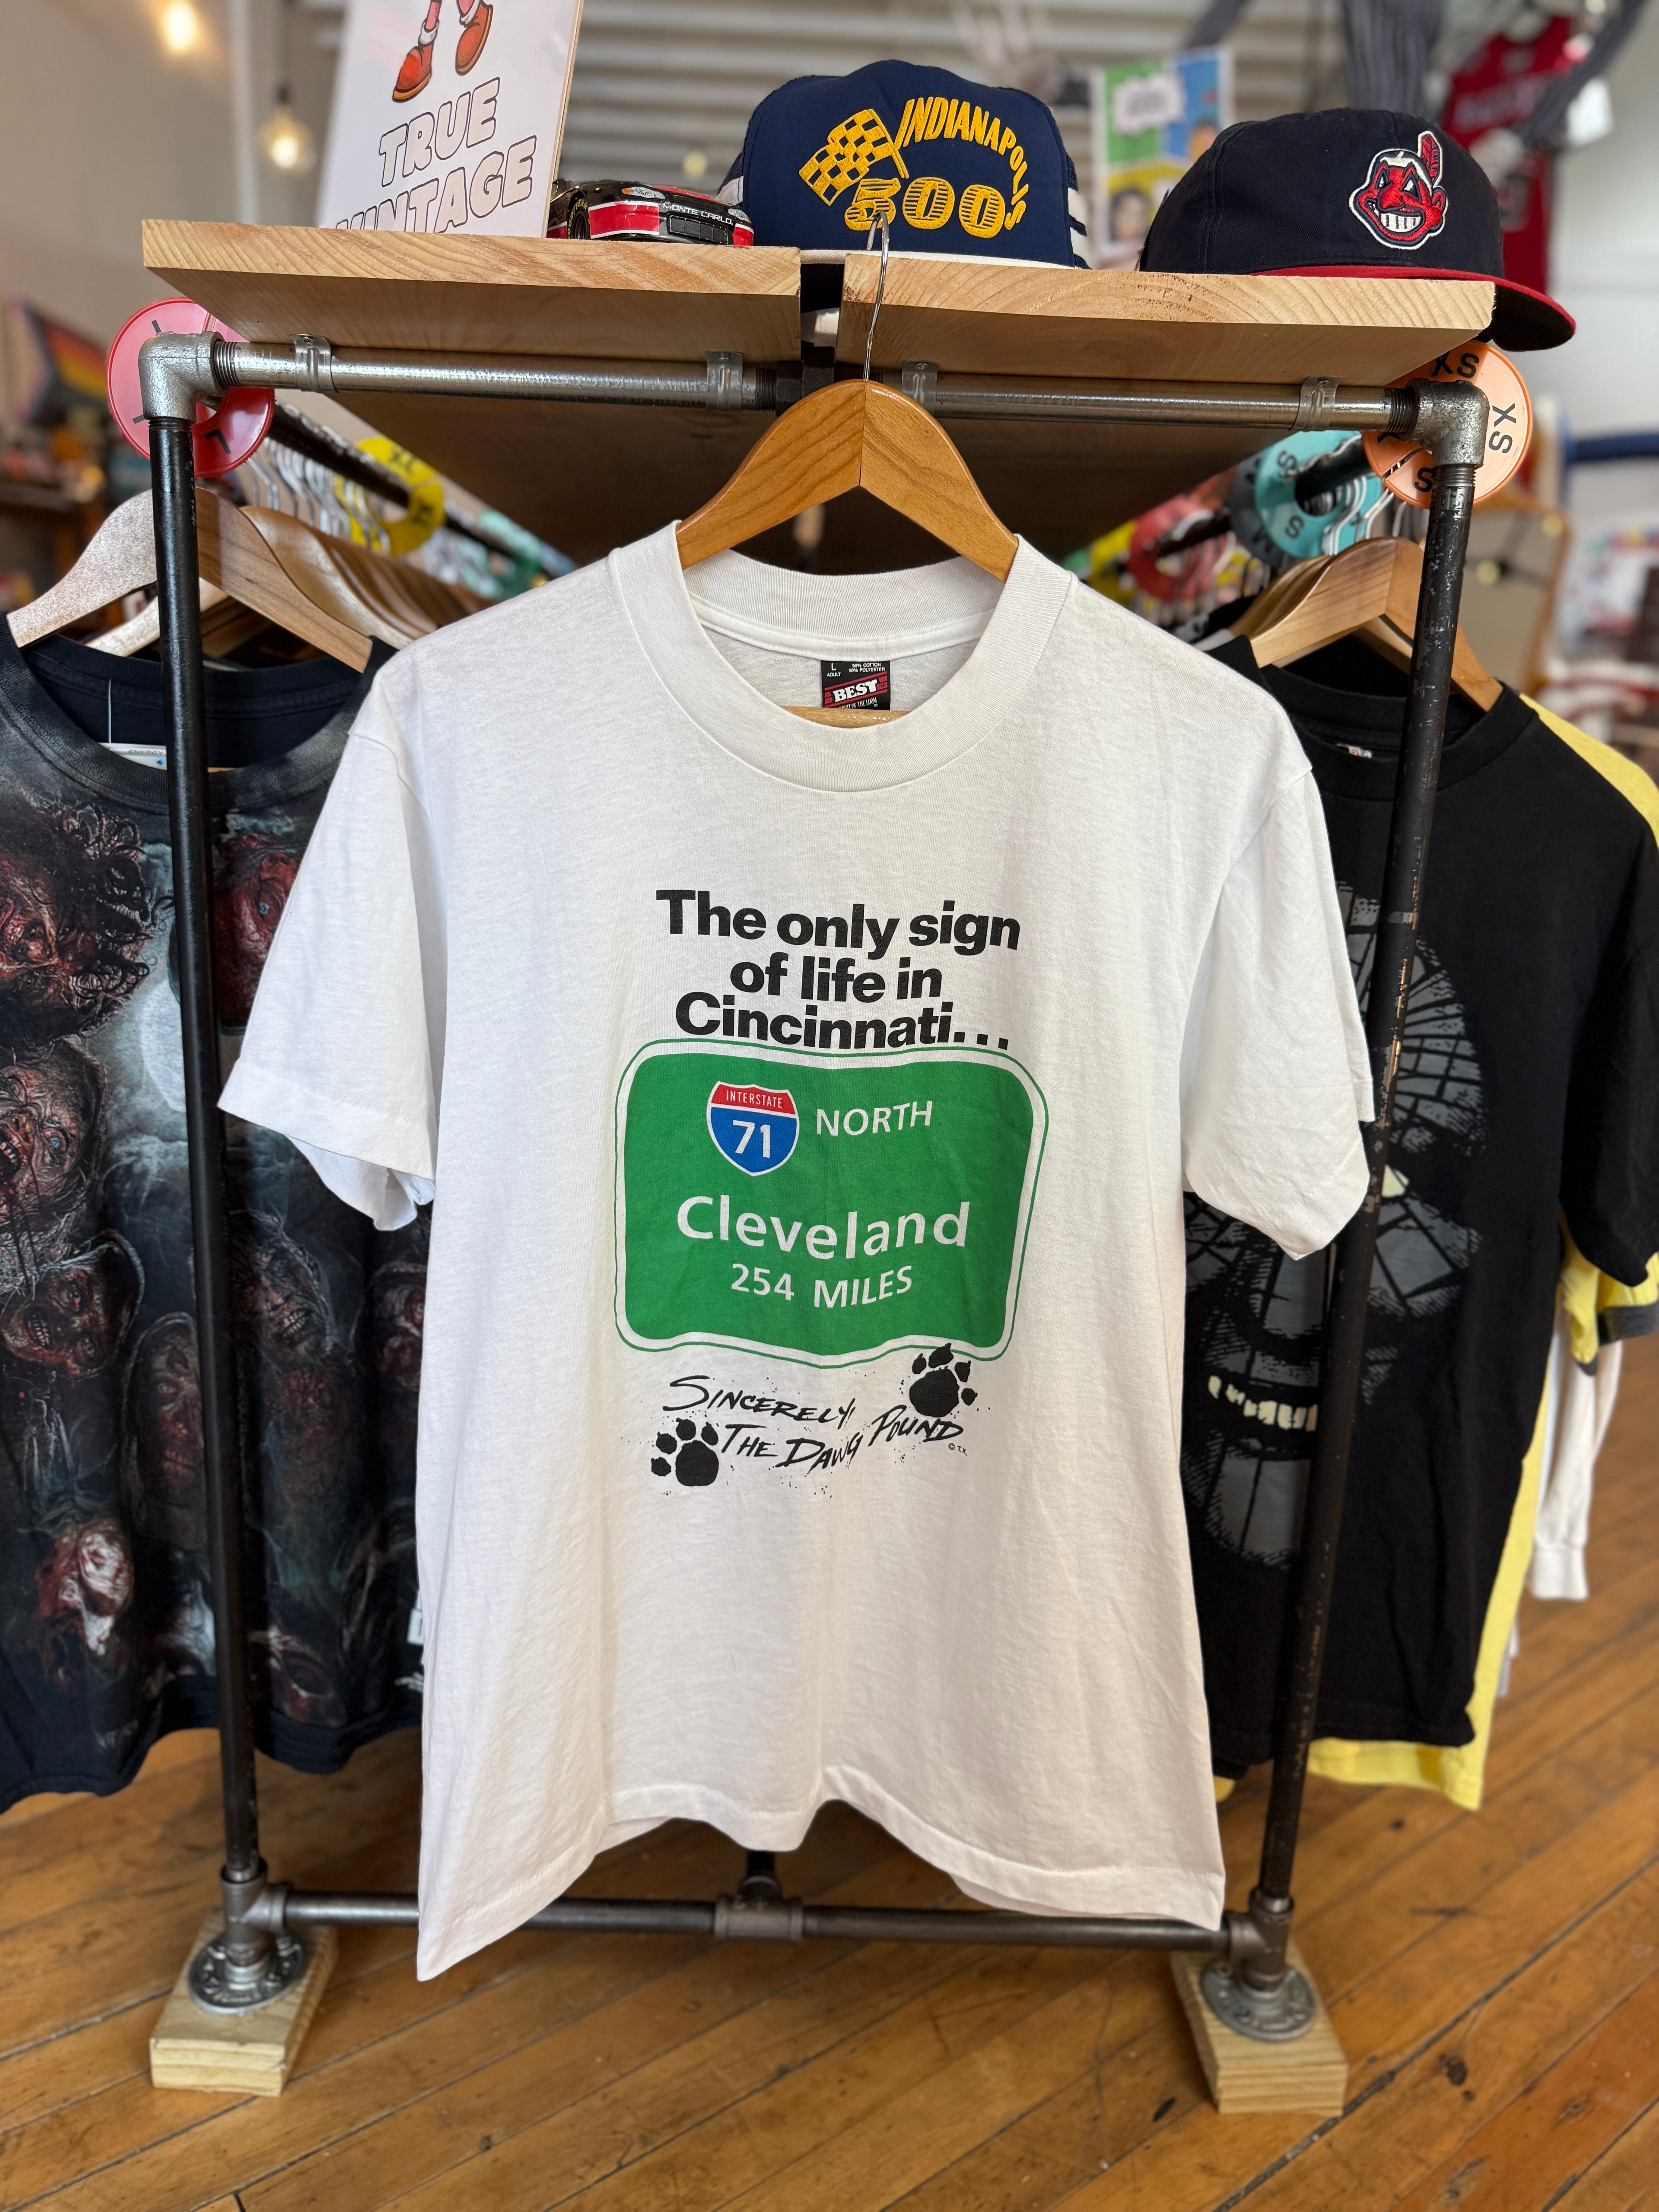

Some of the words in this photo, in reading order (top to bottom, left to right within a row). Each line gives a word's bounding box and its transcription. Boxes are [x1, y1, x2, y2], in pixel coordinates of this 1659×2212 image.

[379, 76, 500, 188] TRUE
[336, 135, 537, 234] NTAGE
[894, 96, 1029, 230] INDIANAPOLIS
[663, 203, 699, 216] MONTE
[844, 176, 1005, 238] 500
[1431, 352, 1480, 378] XS
[1488, 403, 1517, 454] XS
[1285, 516, 1304, 538] S
[831, 663, 836, 671] L
[833, 679, 877, 702] BEST
[866, 697, 877, 706] LOOM
[656, 890, 766, 940] The
[777, 903, 900, 960] only
[909, 900, 1020, 956] sign
[730, 952, 789, 996] of
[801, 956, 886, 1003] life
[896, 957, 942, 1000] in
[726, 1090, 783, 1109] INTERSTATE
[816, 1100, 933, 1137] NORTH
[732, 1119, 771, 1159] 71
[677, 1195, 970, 1260] Cleveland
[731, 1263, 795, 1301] 254
[814, 1265, 912, 1309] MILES
[721, 1424, 778, 1458] THE
[775, 1432, 864, 1471] DAWG
[868, 1405, 964, 1447] POUND
